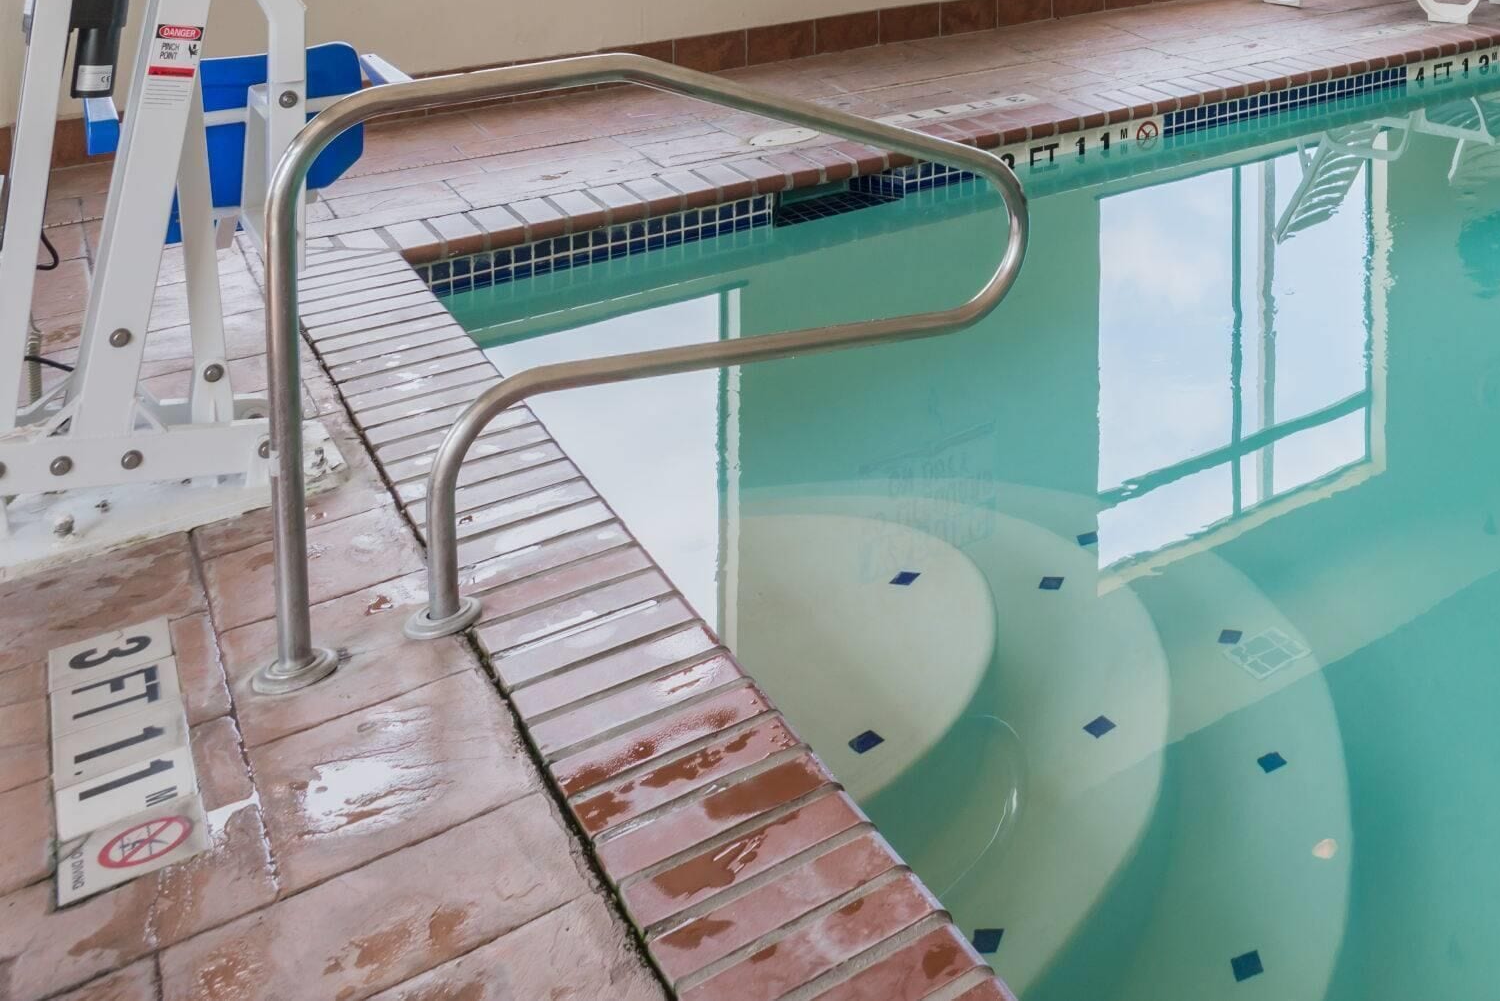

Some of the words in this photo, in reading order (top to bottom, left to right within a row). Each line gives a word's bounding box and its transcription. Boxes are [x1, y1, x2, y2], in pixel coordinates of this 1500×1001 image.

[163, 27, 196, 38] DANGER
[160, 51, 178, 60] POINT
[161, 42, 180, 51] PINCH
[68, 635, 152, 670] 3
[71, 664, 160, 721] FT
[145, 785, 178, 808] M
[72, 860, 86, 891] DIVING
